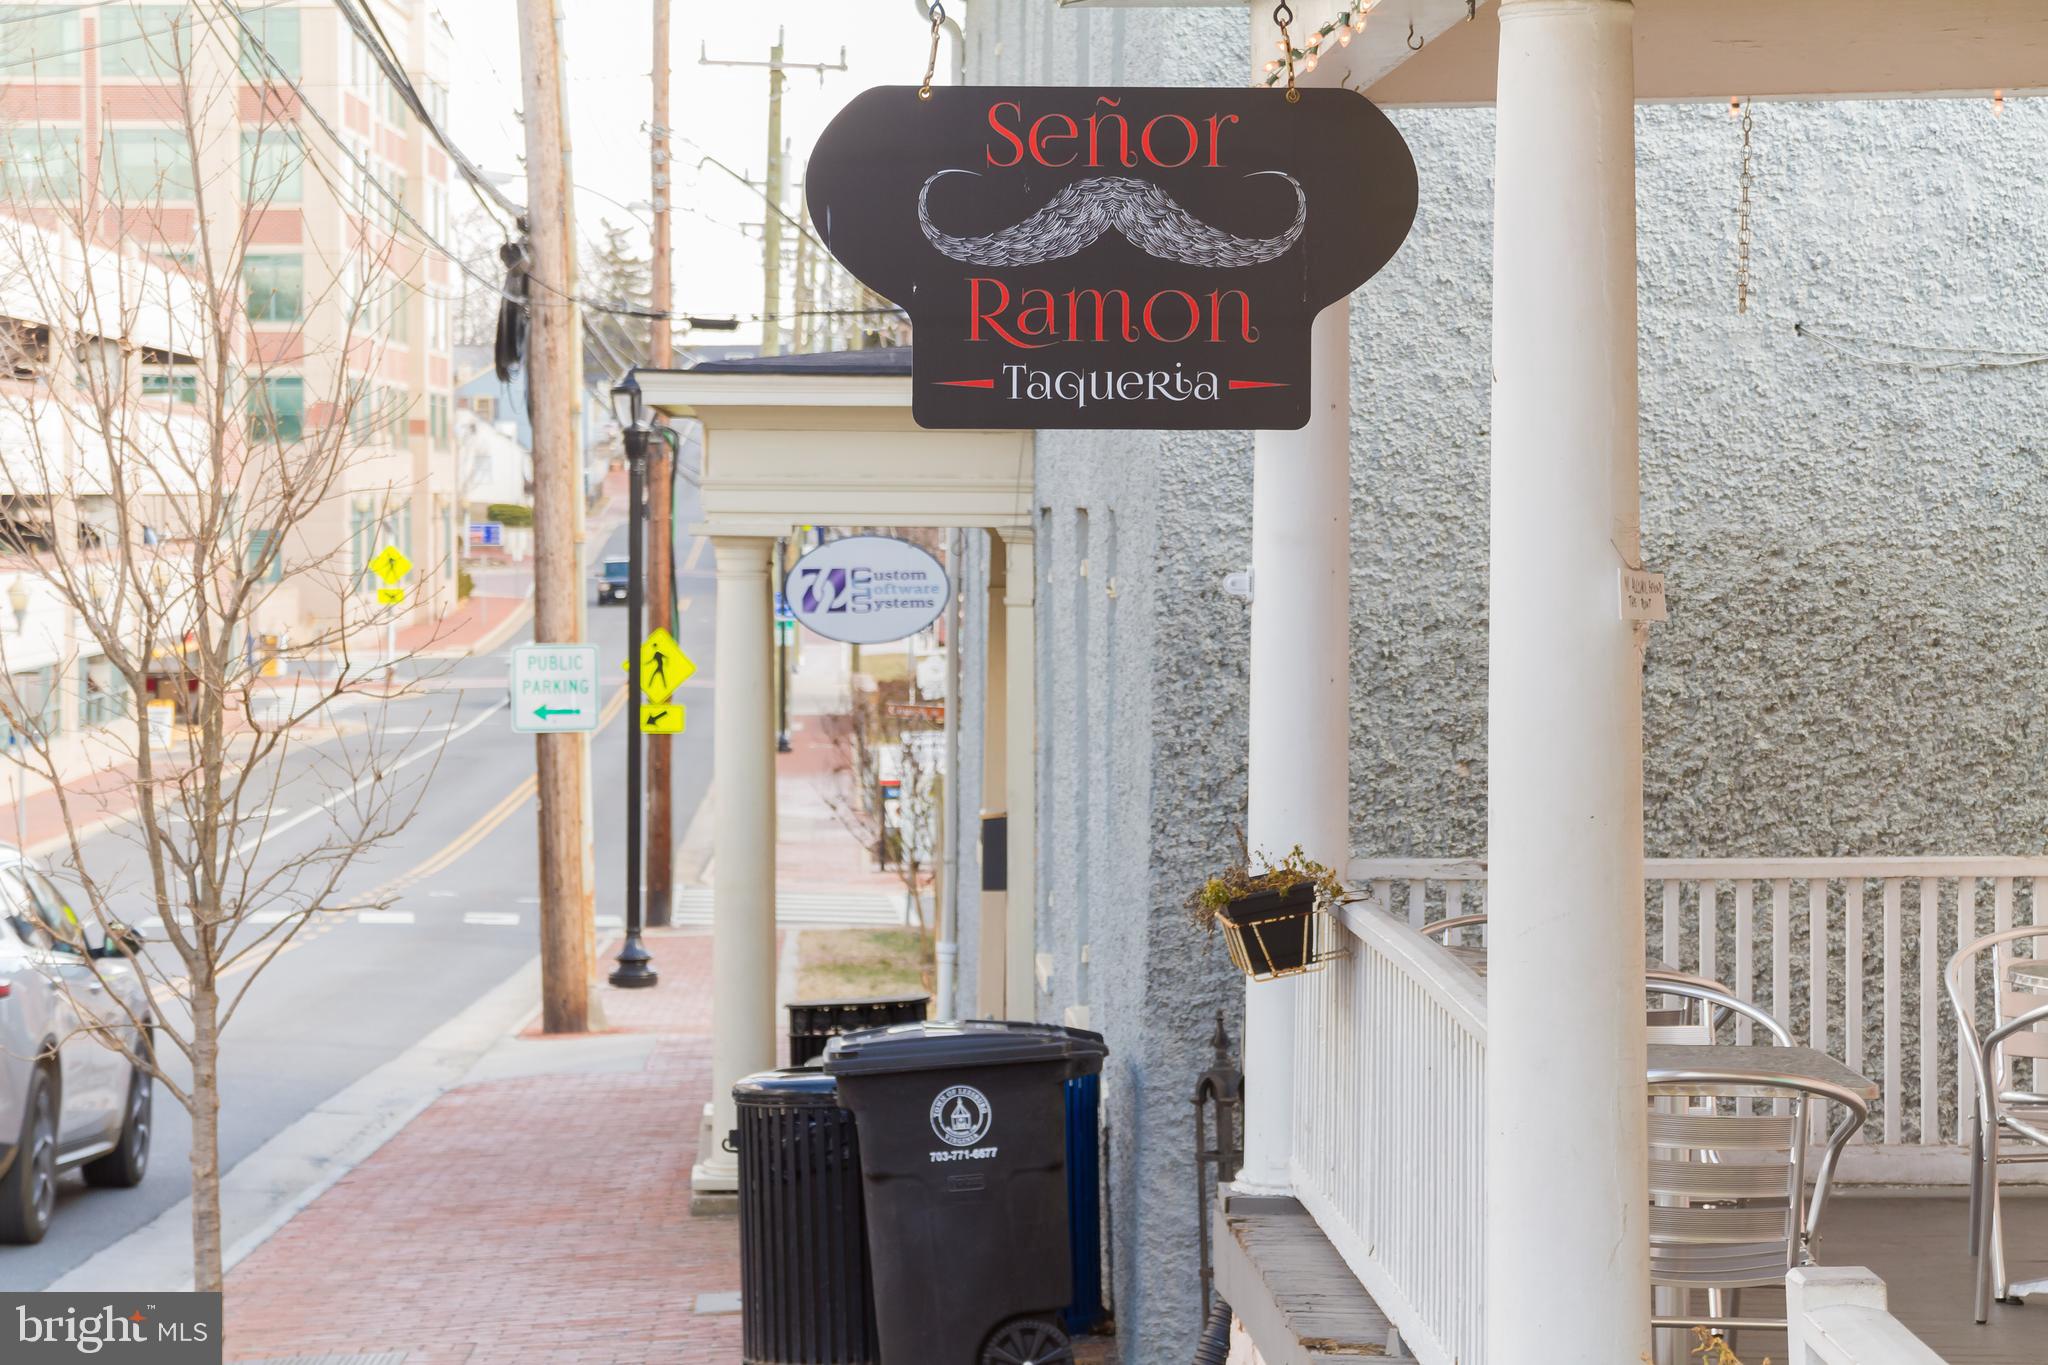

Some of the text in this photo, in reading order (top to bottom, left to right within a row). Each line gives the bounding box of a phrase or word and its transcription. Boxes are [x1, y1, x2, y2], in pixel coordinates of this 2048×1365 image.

[987, 97, 1239, 169] Señor
[965, 277, 1260, 349] Ramon
[1003, 362, 1219, 408] Taqueria
[852, 567, 927, 583] Custom
[852, 581, 940, 598] Software
[852, 595, 934, 613] Systems
[528, 655, 583, 671] PUBLIC
[522, 679, 589, 694] PARKING
